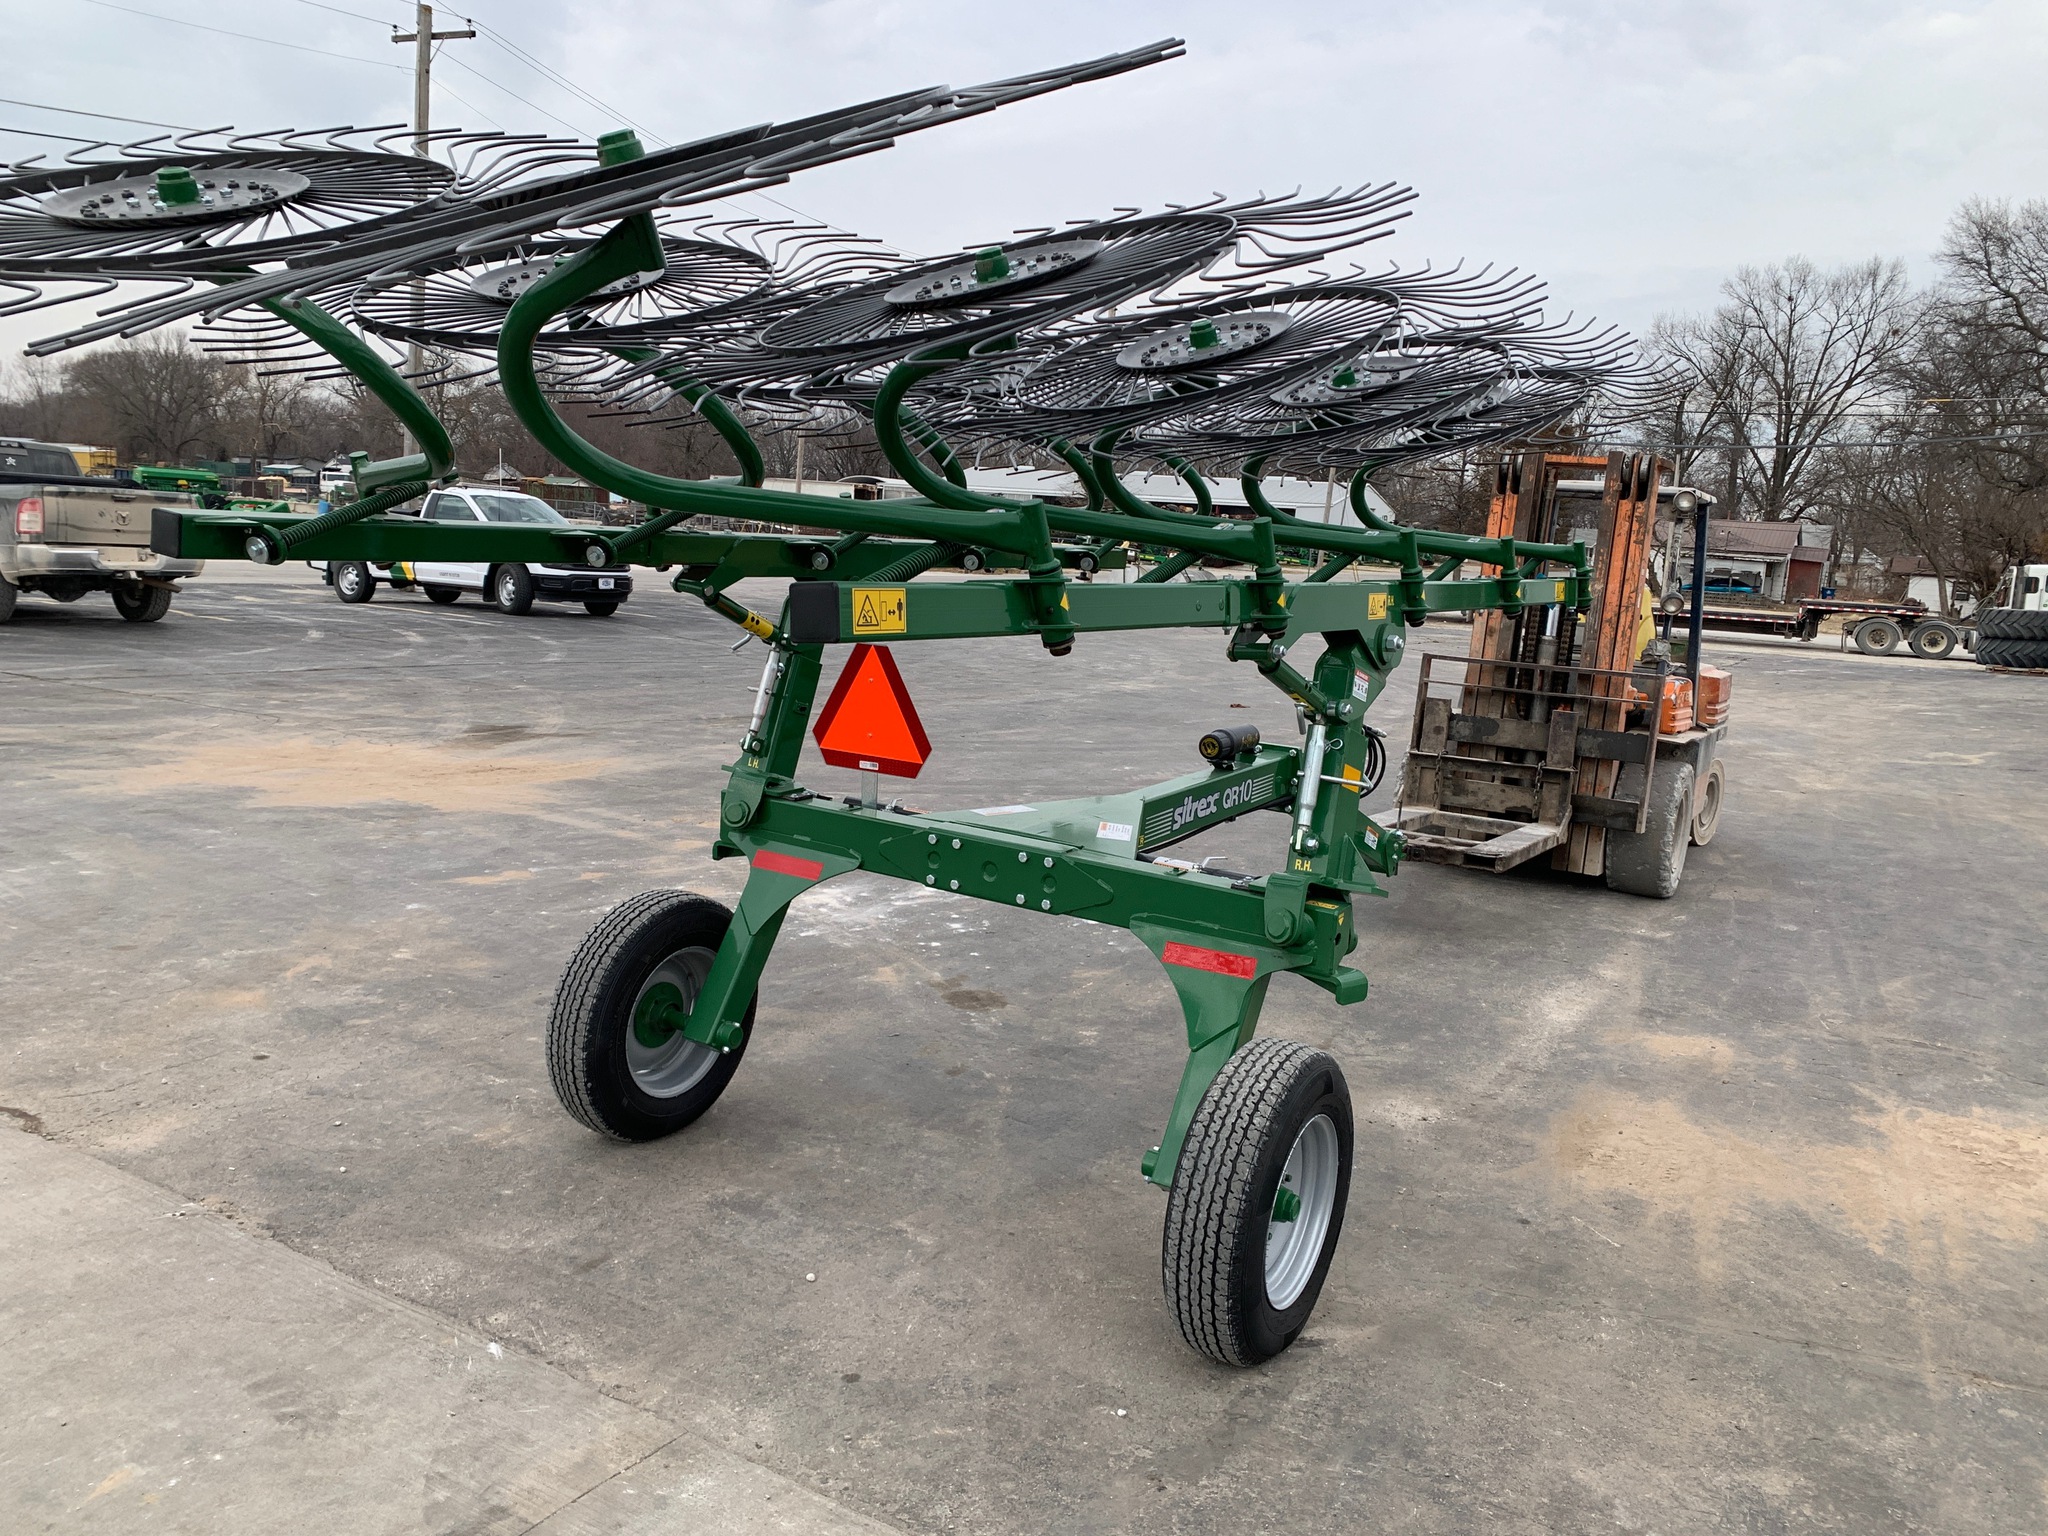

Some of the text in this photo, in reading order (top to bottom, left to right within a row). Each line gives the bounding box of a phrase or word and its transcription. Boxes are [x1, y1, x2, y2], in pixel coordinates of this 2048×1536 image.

[1172, 792, 1220, 831] sitrex
[1222, 778, 1253, 809] QR10
[1294, 858, 1312, 872] R.H.
